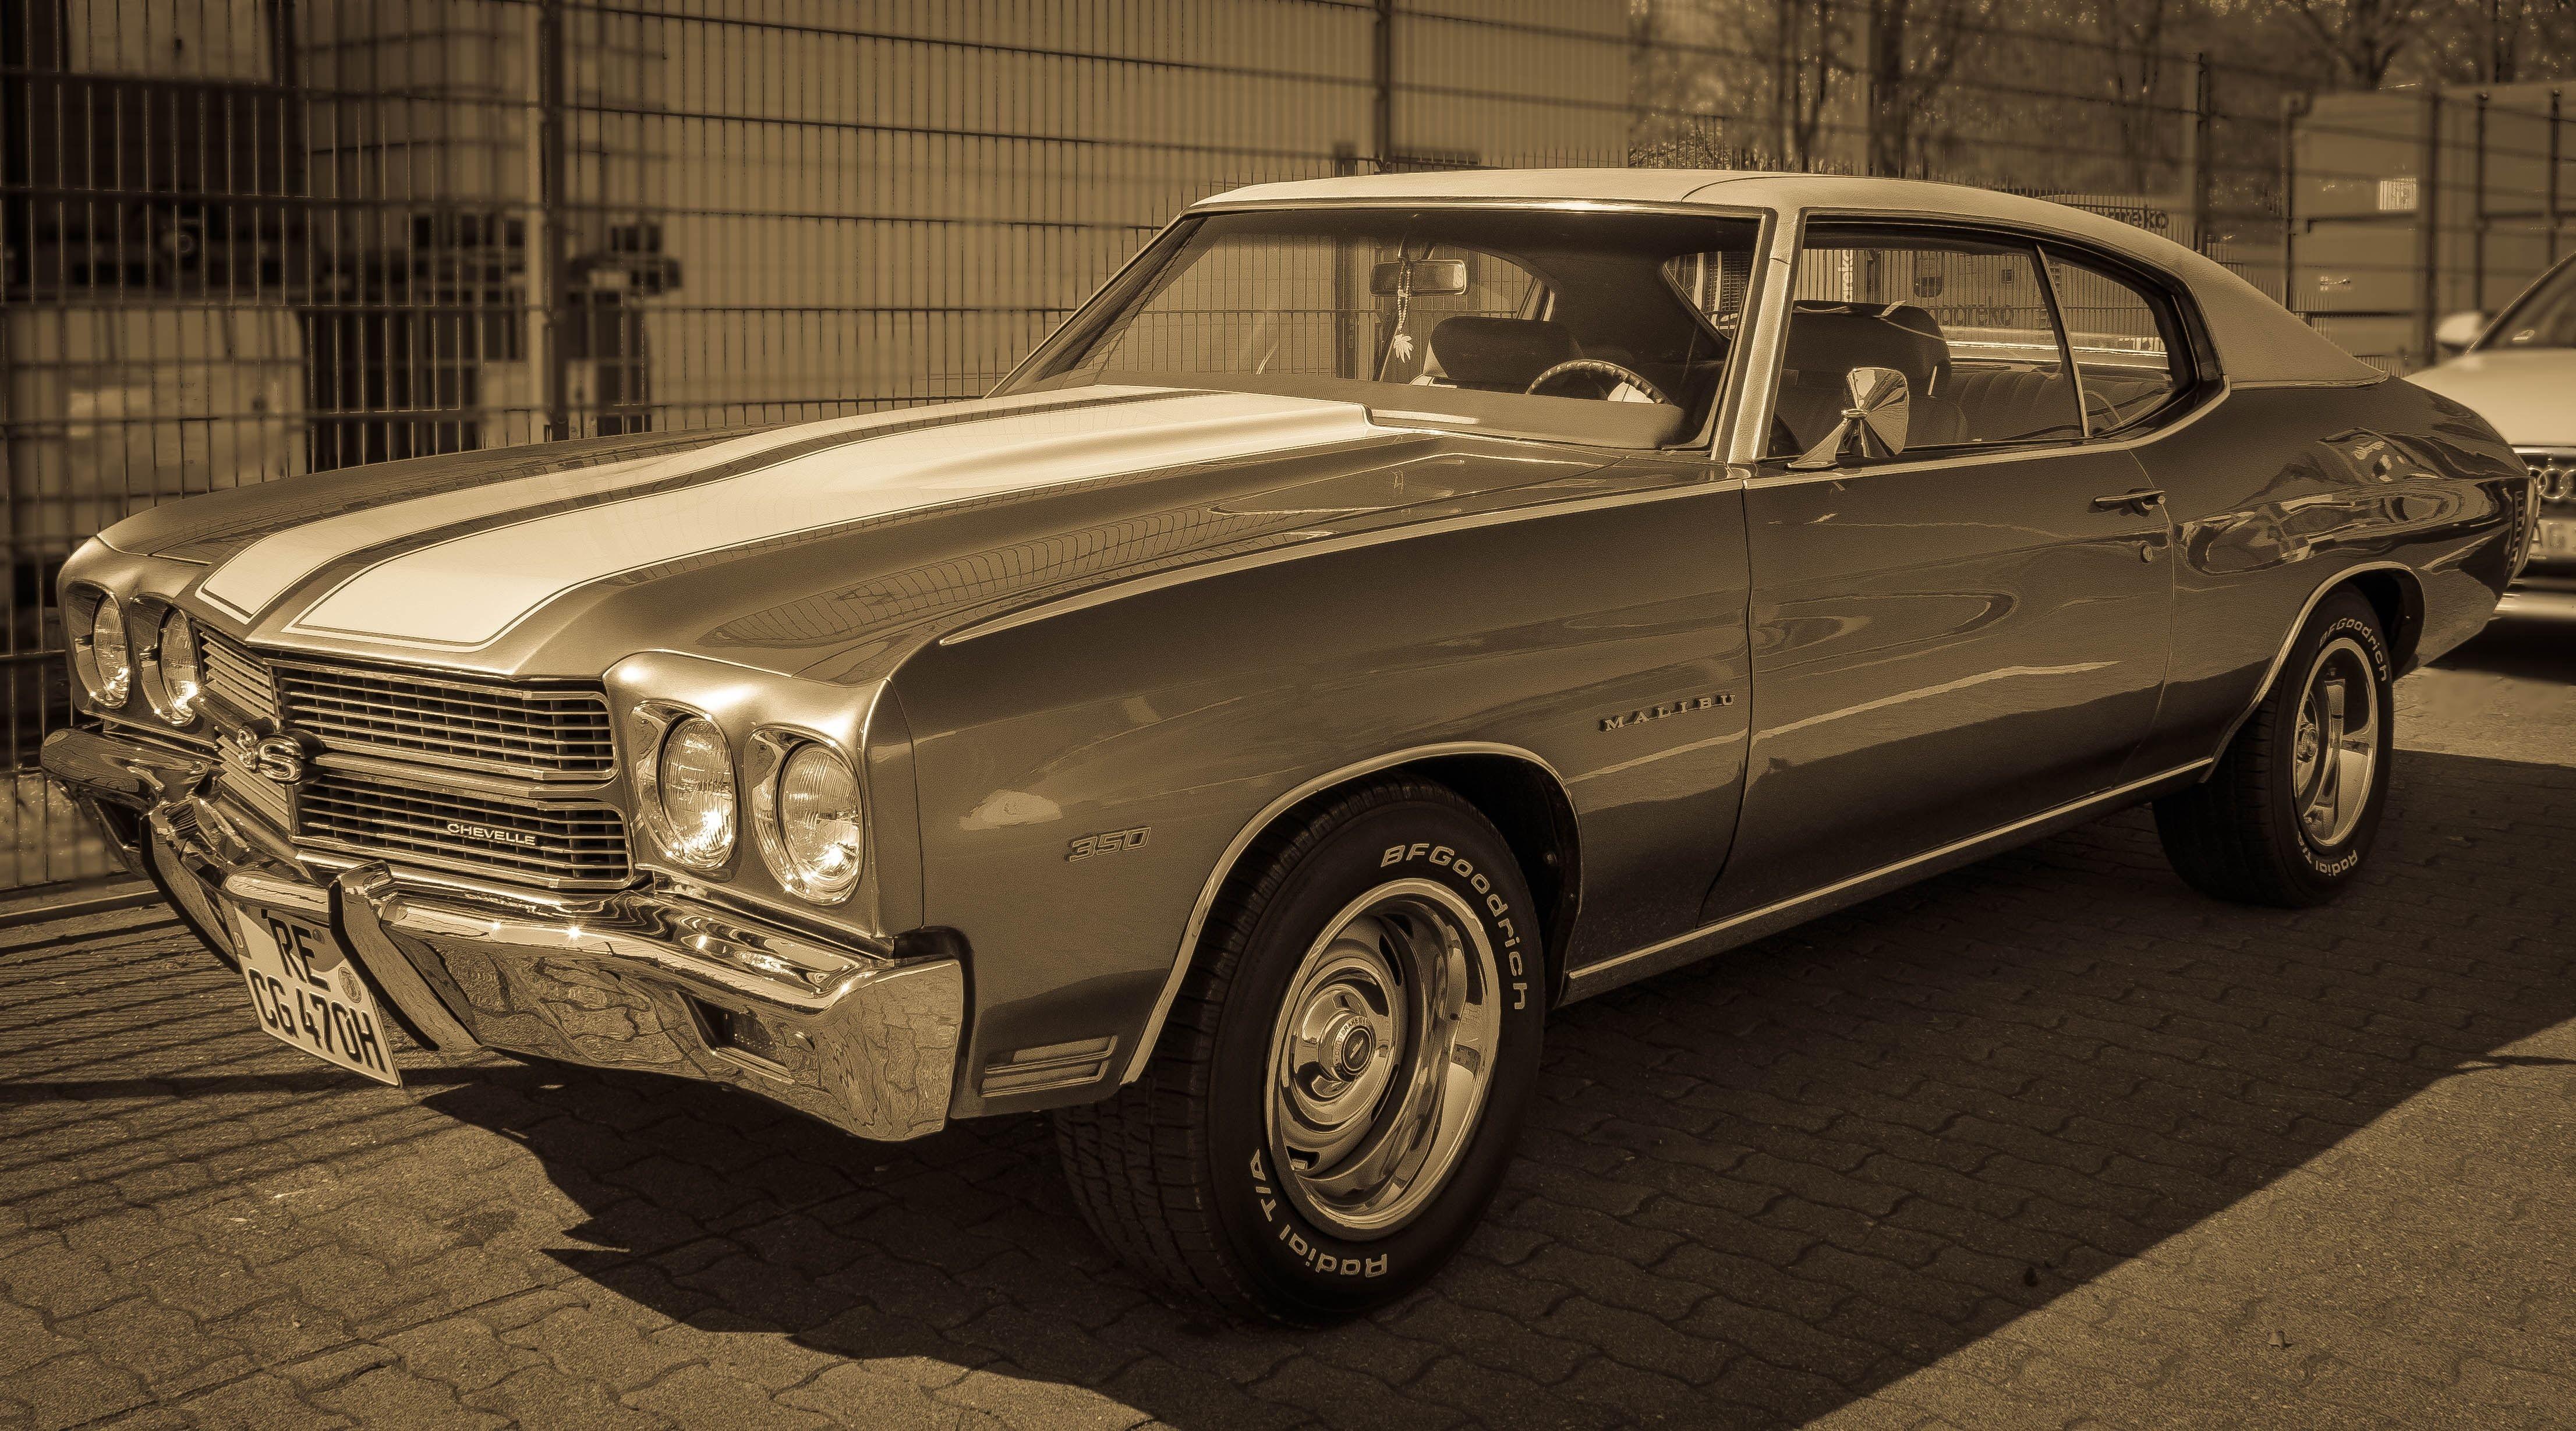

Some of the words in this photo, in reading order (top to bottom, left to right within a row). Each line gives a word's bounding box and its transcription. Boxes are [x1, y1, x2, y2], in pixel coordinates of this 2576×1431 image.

[2319, 618, 2387, 681] BFGoodrich
[1605, 694, 1736, 731] MALIBU
[236, 726, 304, 784] SS
[447, 817, 536, 846] CHEVELLE
[1069, 827, 1152, 862] 350
[2316, 849, 2358, 876] Radial
[267, 917, 331, 993] RE
[1381, 843, 1527, 1010] BFGoodrich
[296, 986, 388, 1074] 470H
[1250, 1149, 1276, 1222] T/A
[1279, 1224, 1385, 1278] Radial
